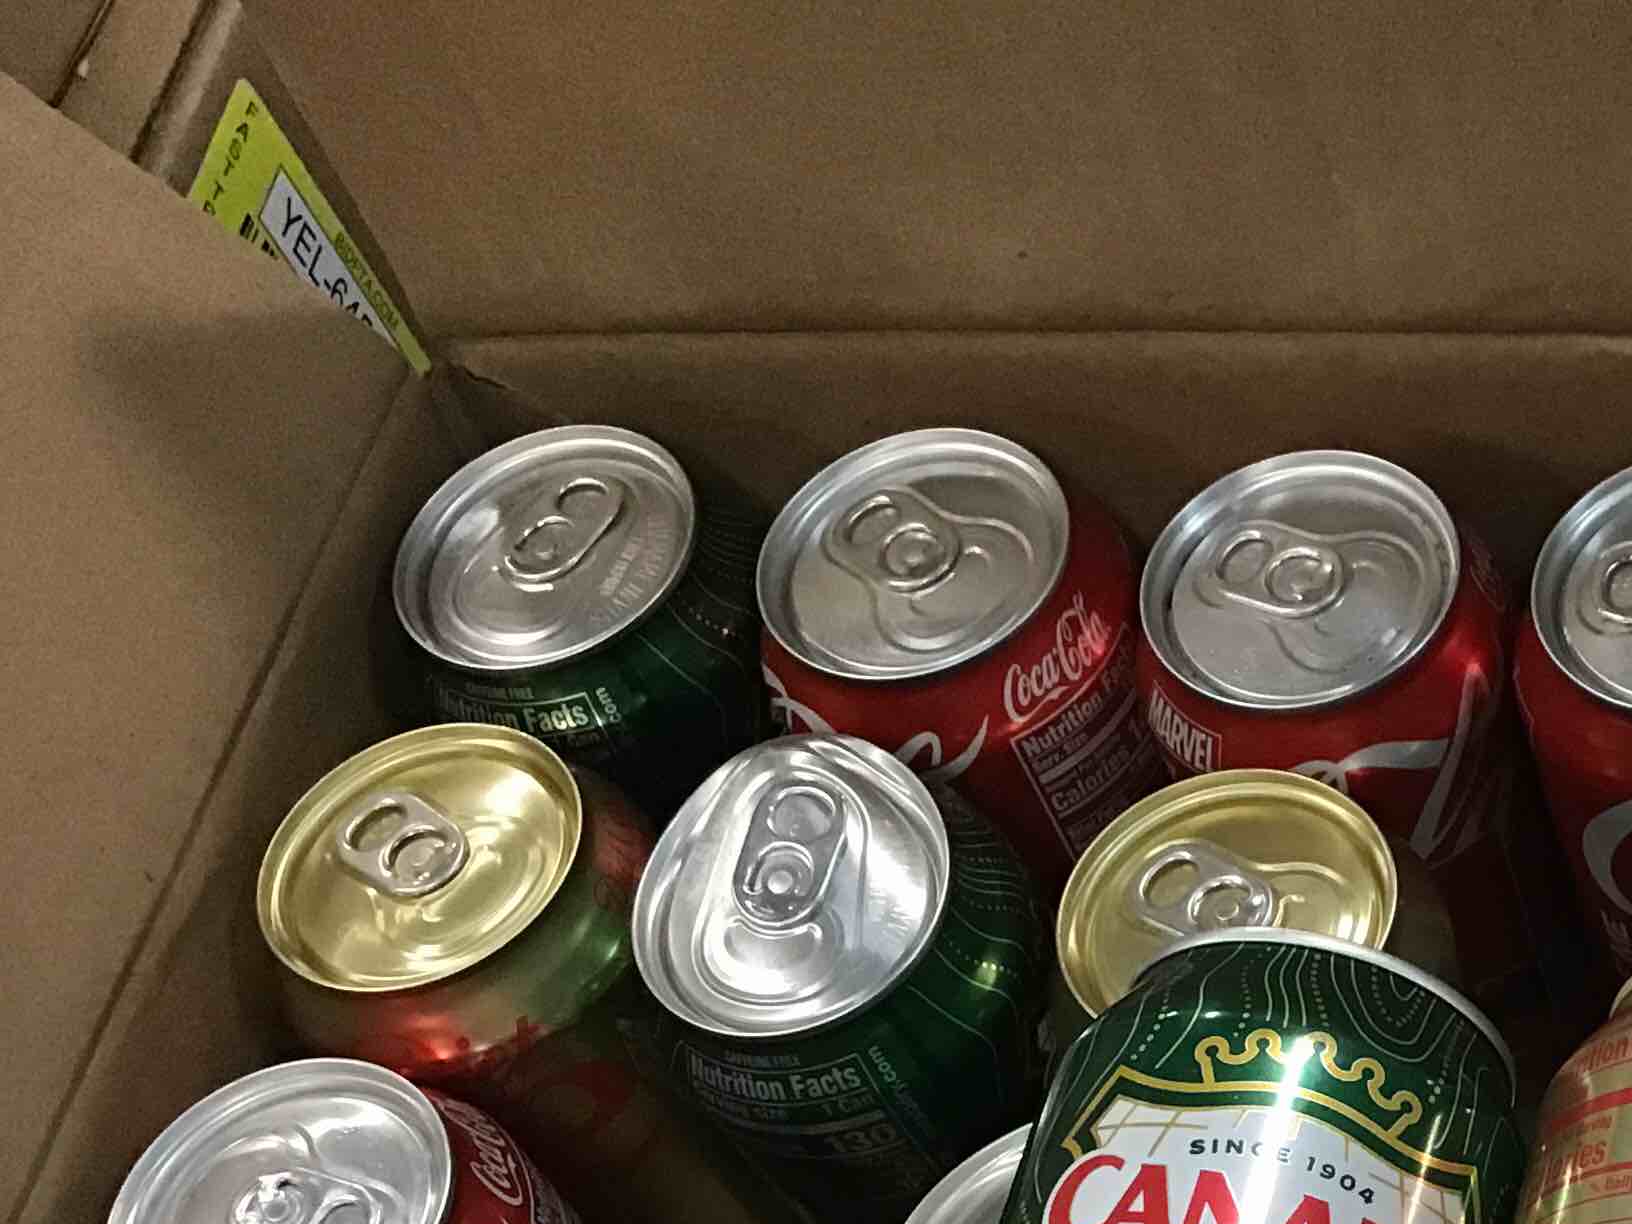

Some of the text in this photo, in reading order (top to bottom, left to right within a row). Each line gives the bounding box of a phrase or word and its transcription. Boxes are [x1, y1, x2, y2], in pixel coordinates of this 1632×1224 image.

[523, 702, 590, 733] Facts
[1149, 686, 1214, 771] MARVEL
[789, 1066, 861, 1101] Facts
[1304, 1154, 1378, 1205] 1904
